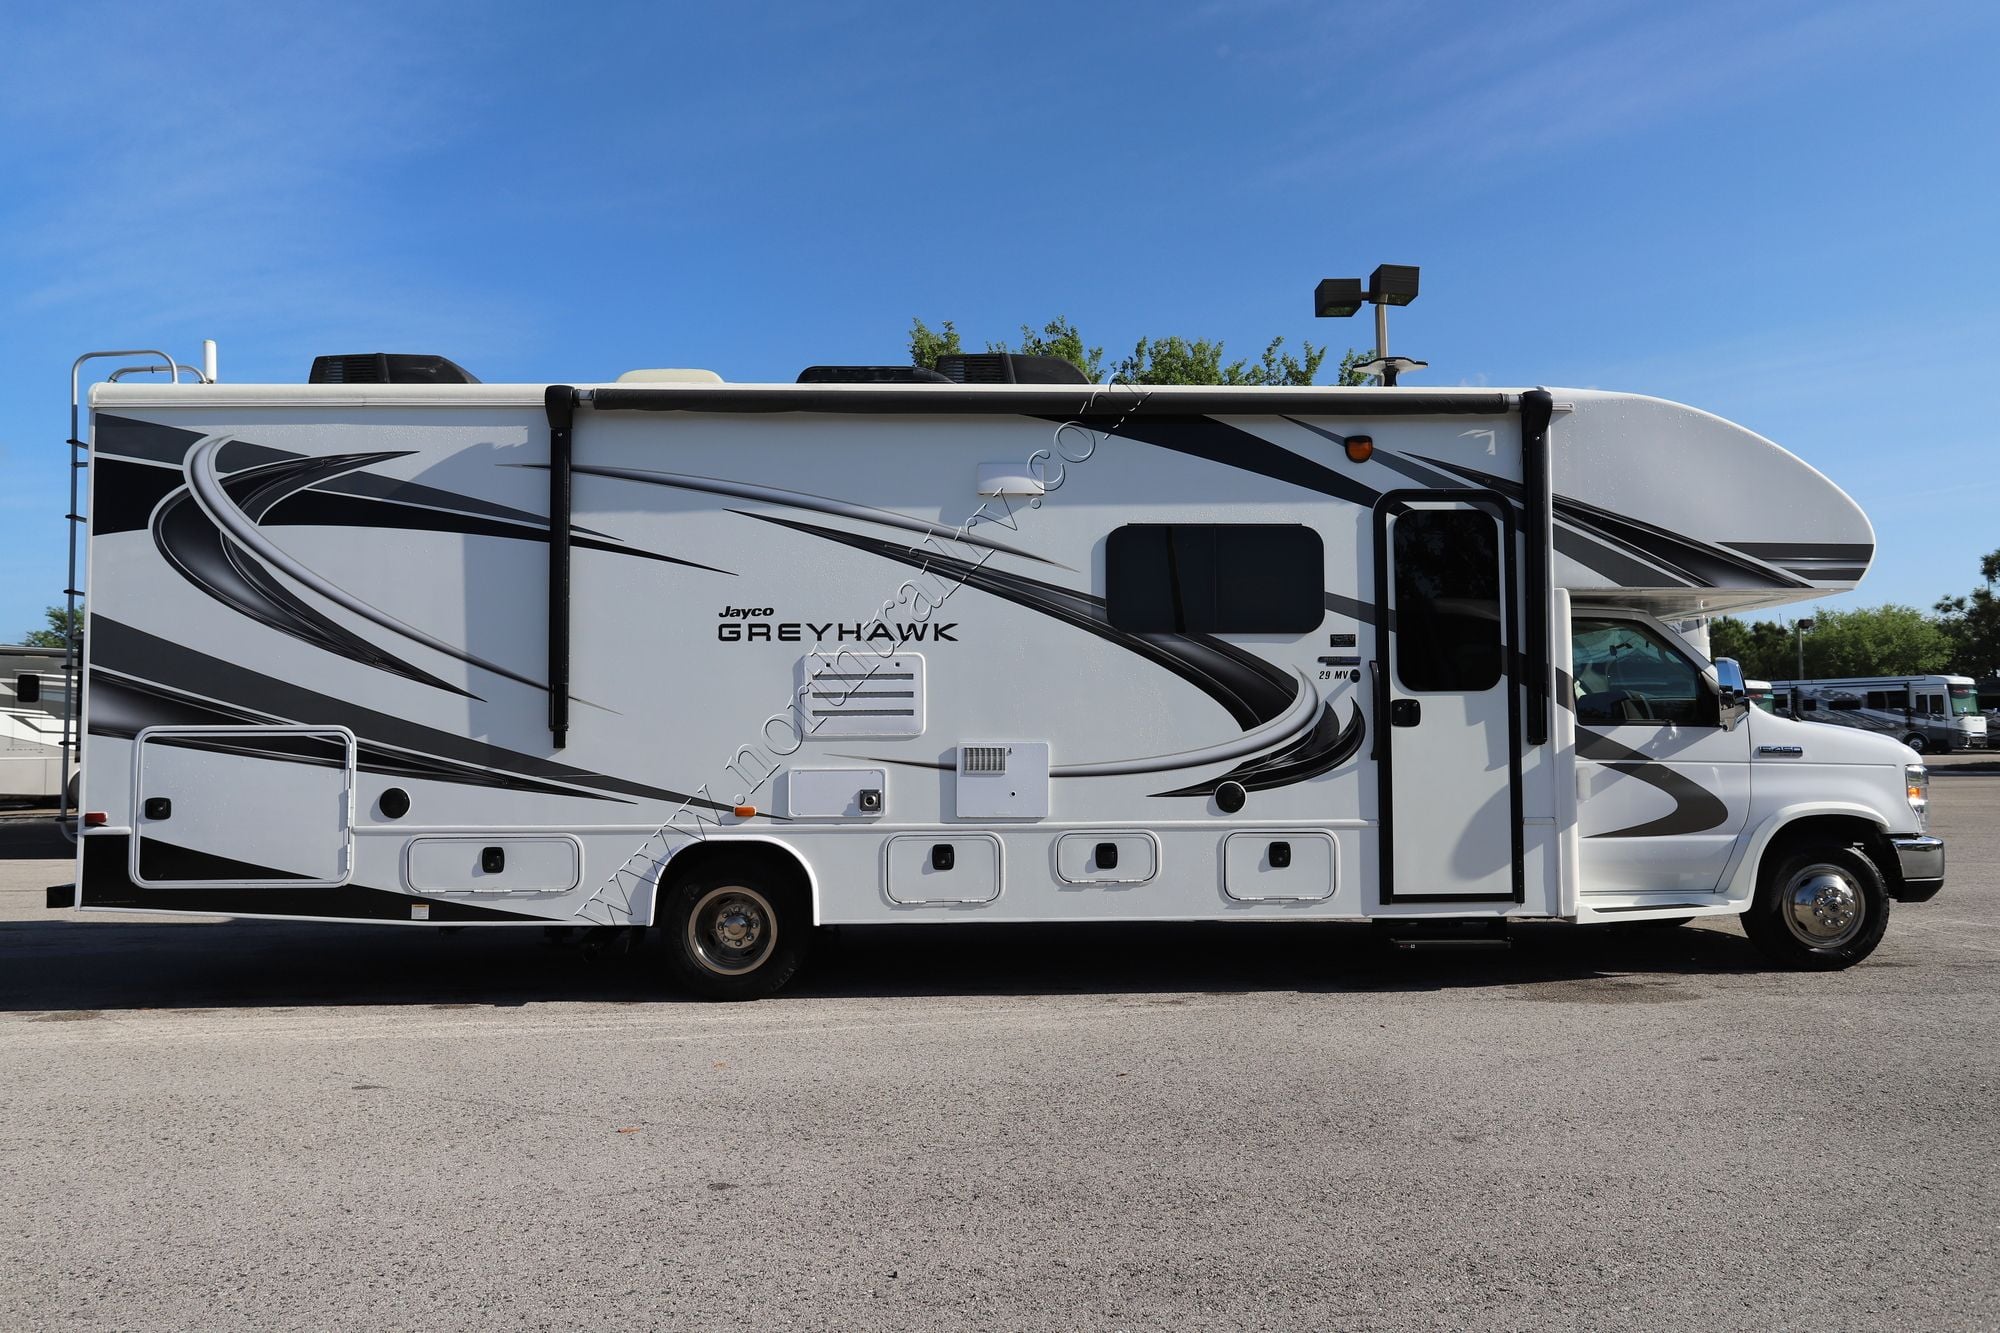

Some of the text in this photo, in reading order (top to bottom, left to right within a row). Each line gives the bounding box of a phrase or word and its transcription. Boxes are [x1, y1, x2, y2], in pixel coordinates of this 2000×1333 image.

[718, 605, 775, 620] Jayco
[717, 622, 959, 642] GREYHAWK
[1318, 670, 1349, 680] 29 MV
